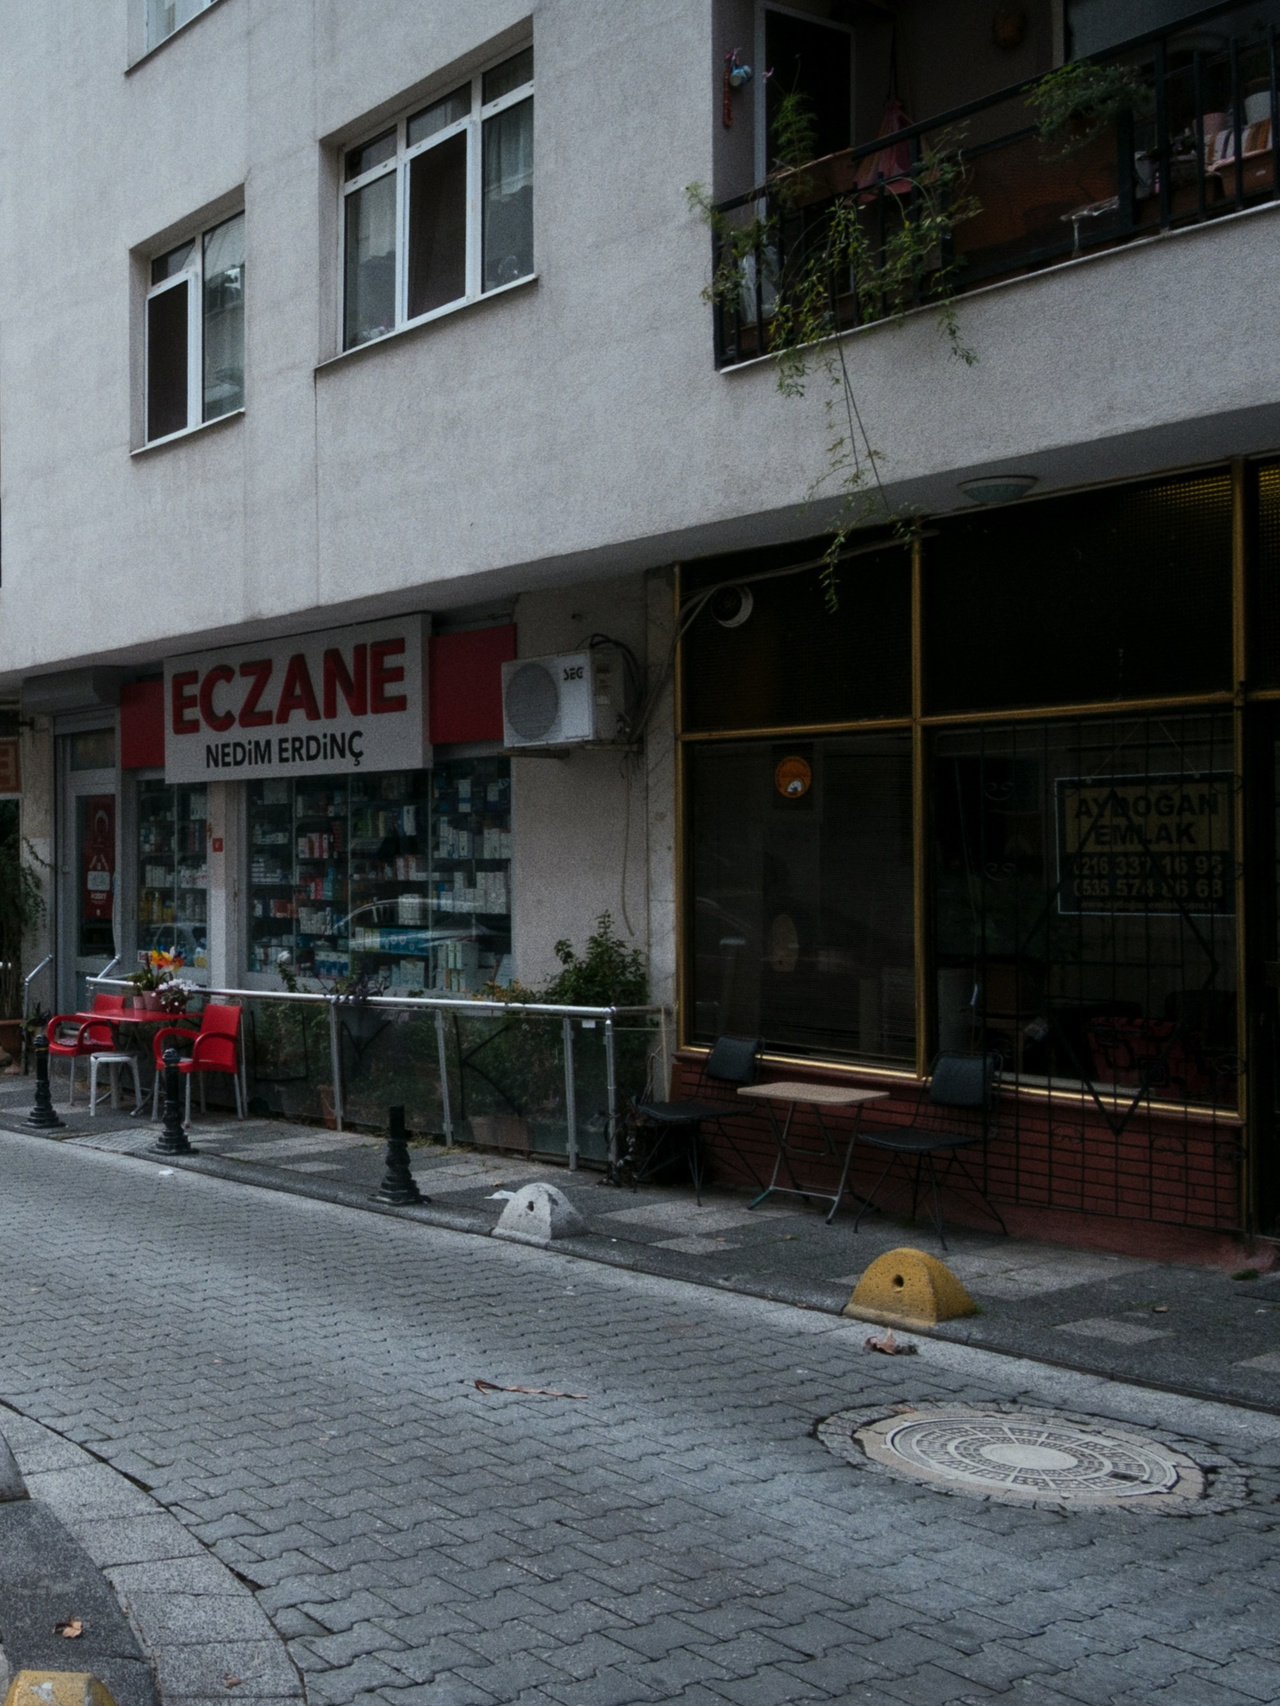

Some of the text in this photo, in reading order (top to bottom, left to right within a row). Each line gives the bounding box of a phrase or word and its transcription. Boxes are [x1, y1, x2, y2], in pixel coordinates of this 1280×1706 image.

[563, 666, 585, 681] SEG
[171, 637, 408, 735] ECZANE
[1075, 789, 1219, 818] AYDOĞAN
[1094, 822, 1196, 845] EMLAK
[1161, 855, 1189, 875] 16
[1195, 878, 1223, 899] 68
